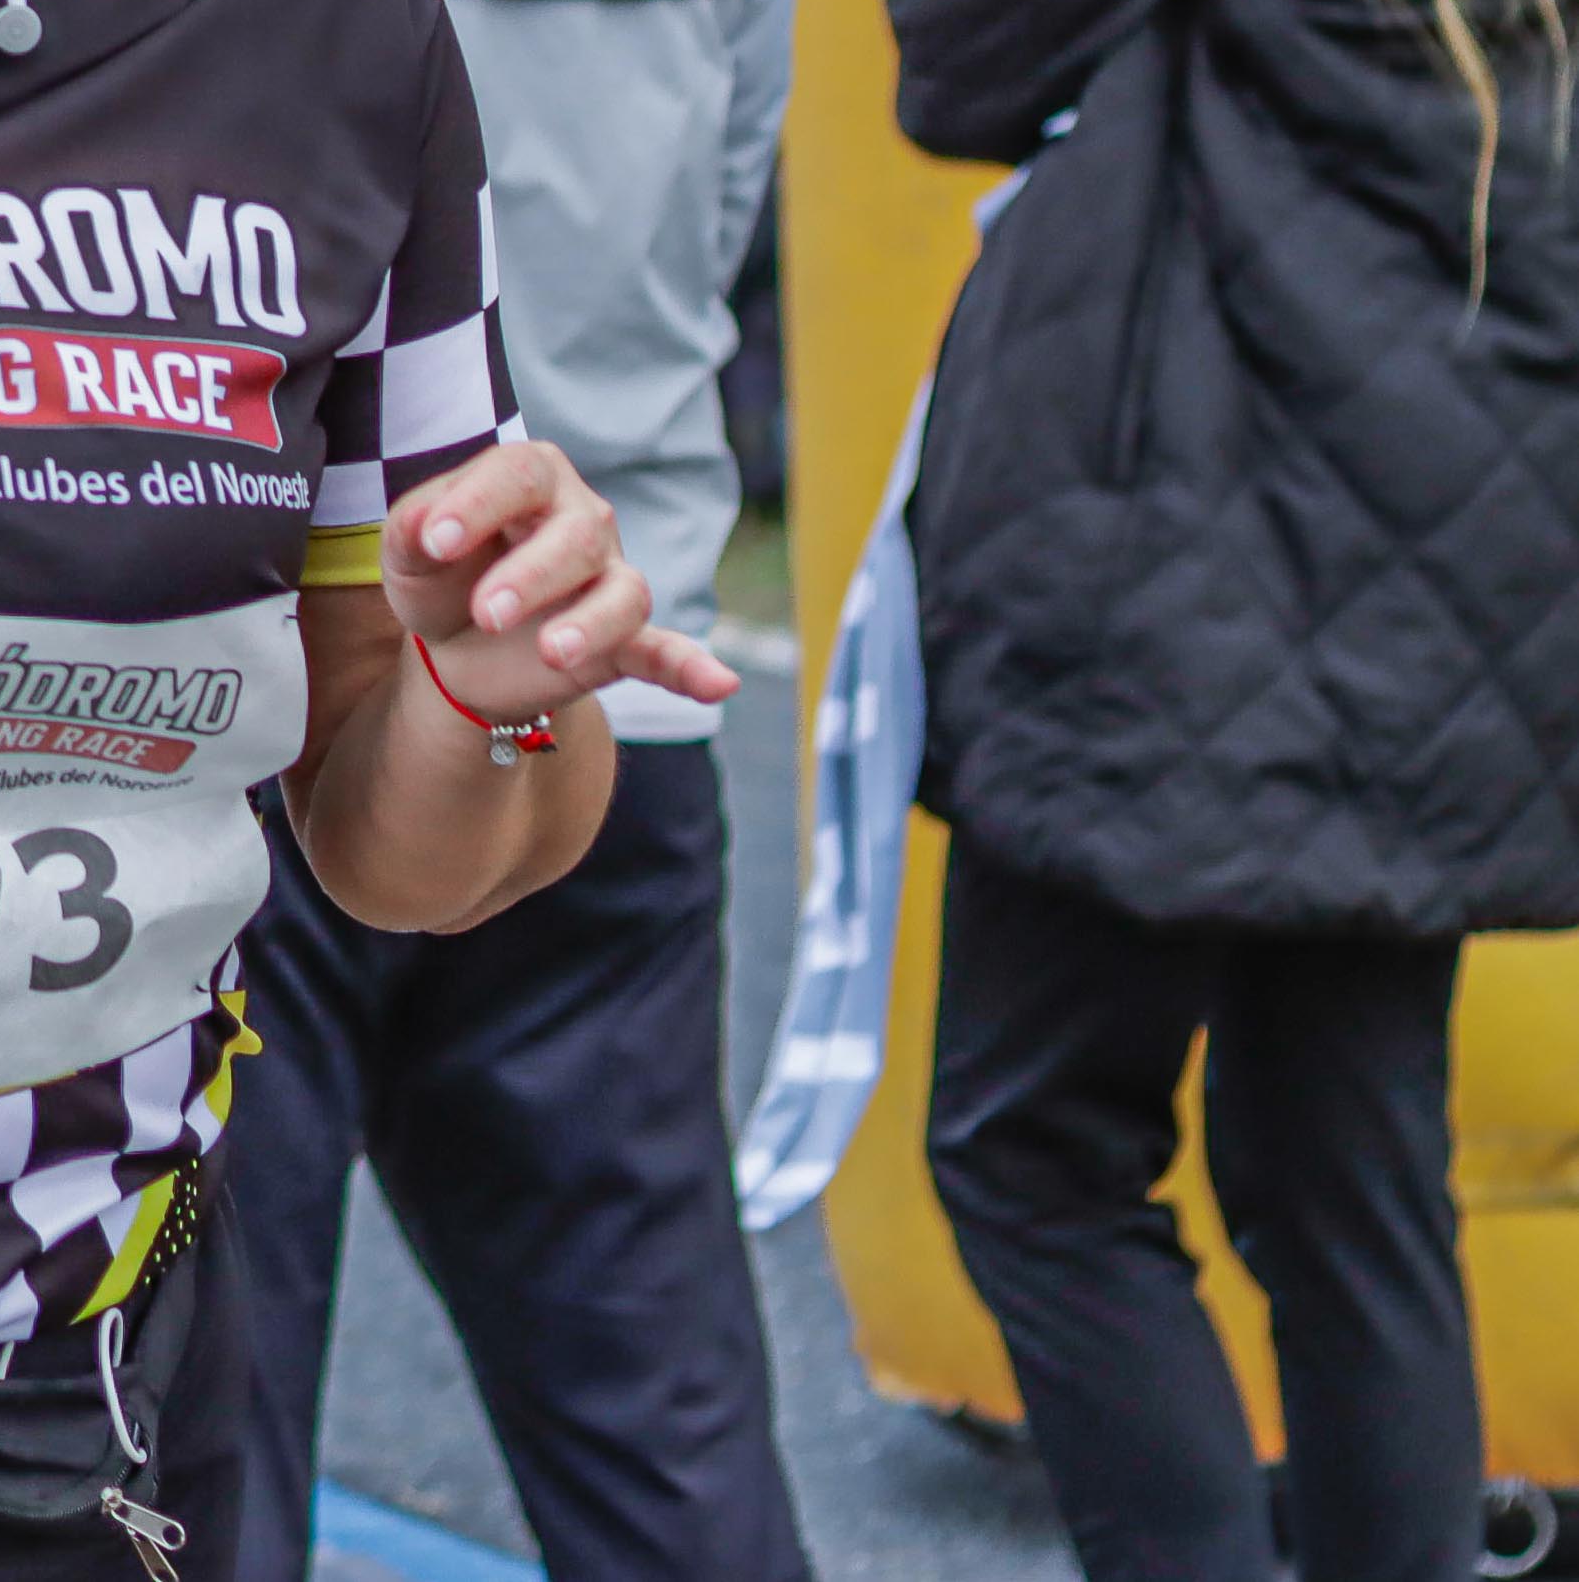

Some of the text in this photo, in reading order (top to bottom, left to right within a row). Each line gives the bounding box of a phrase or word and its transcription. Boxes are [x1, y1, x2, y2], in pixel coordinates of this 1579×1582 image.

[53, 341, 233, 431] RACE
[140, 460, 206, 505] del
[209, 462, 311, 509] Noroeste
[51, 726, 156, 766] RACE
[59, 768, 96, 784] del
